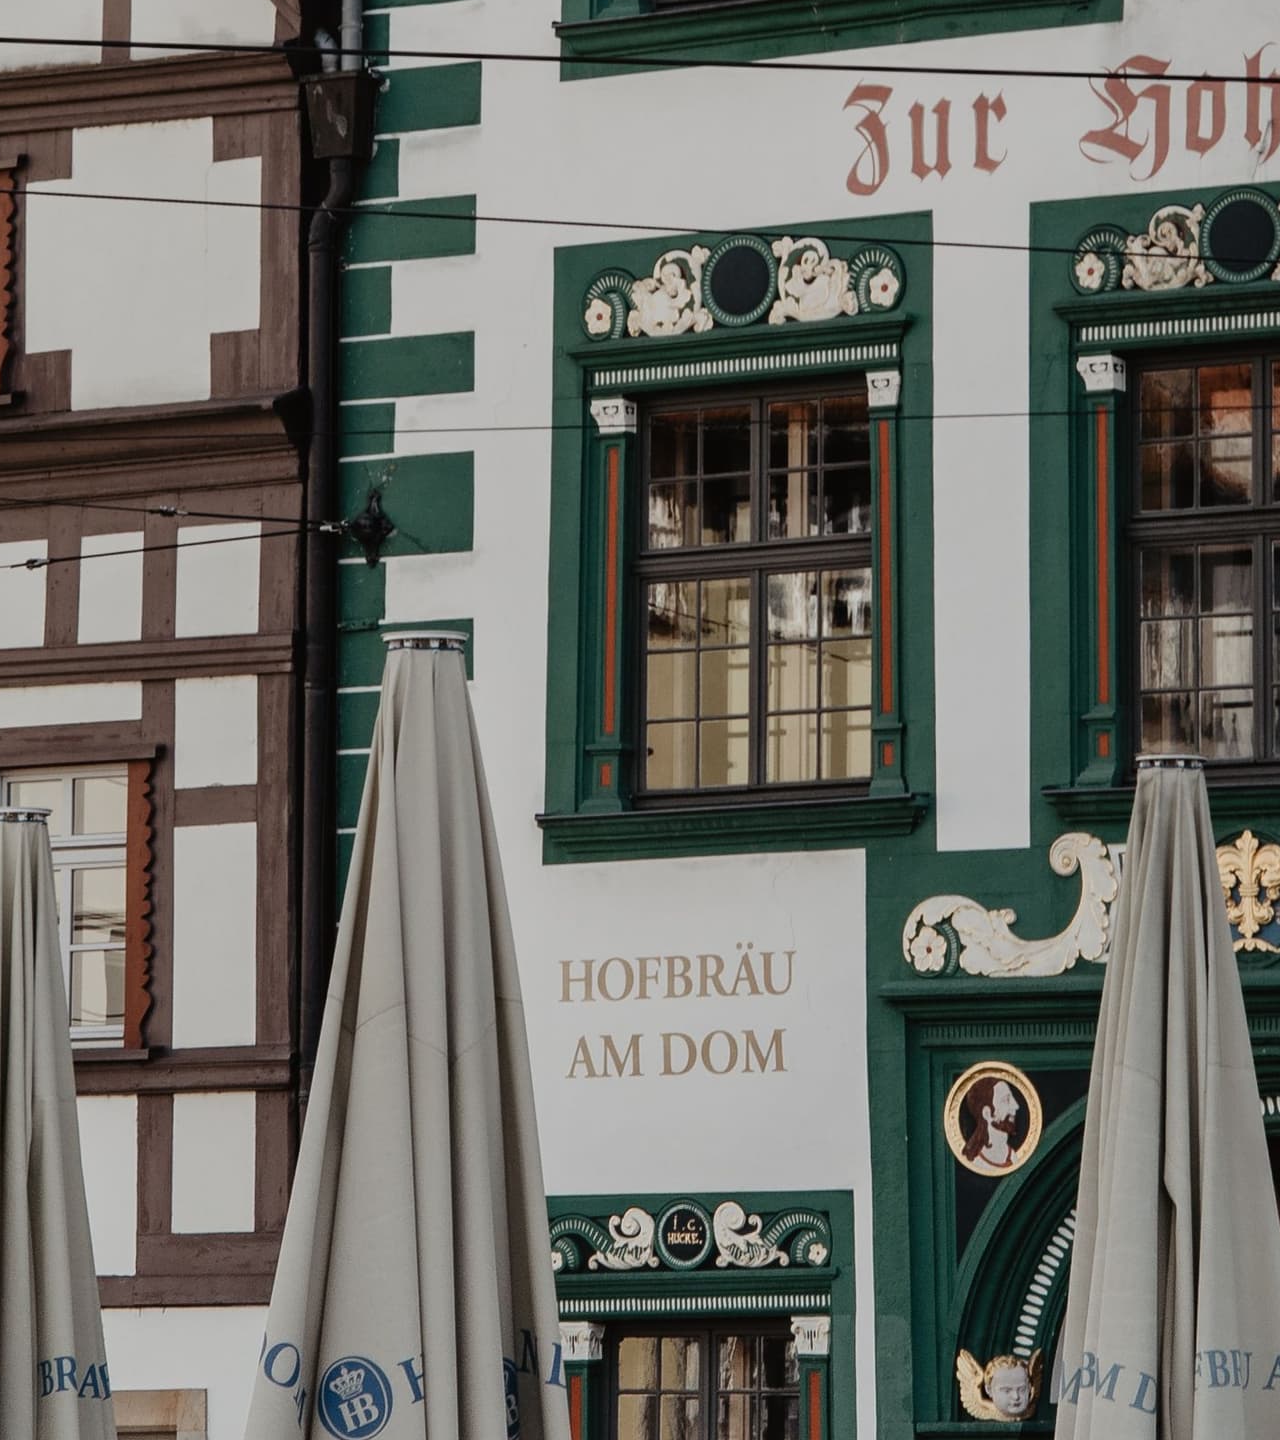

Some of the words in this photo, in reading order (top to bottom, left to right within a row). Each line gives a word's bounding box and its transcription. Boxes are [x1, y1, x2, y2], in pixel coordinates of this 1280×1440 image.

[843, 78, 1008, 197] Zur
[558, 941, 797, 1003] HOFBRÄU
[565, 1032, 644, 1079] AM
[658, 1028, 789, 1077] DOM
[338, 1392, 380, 1433] HB
